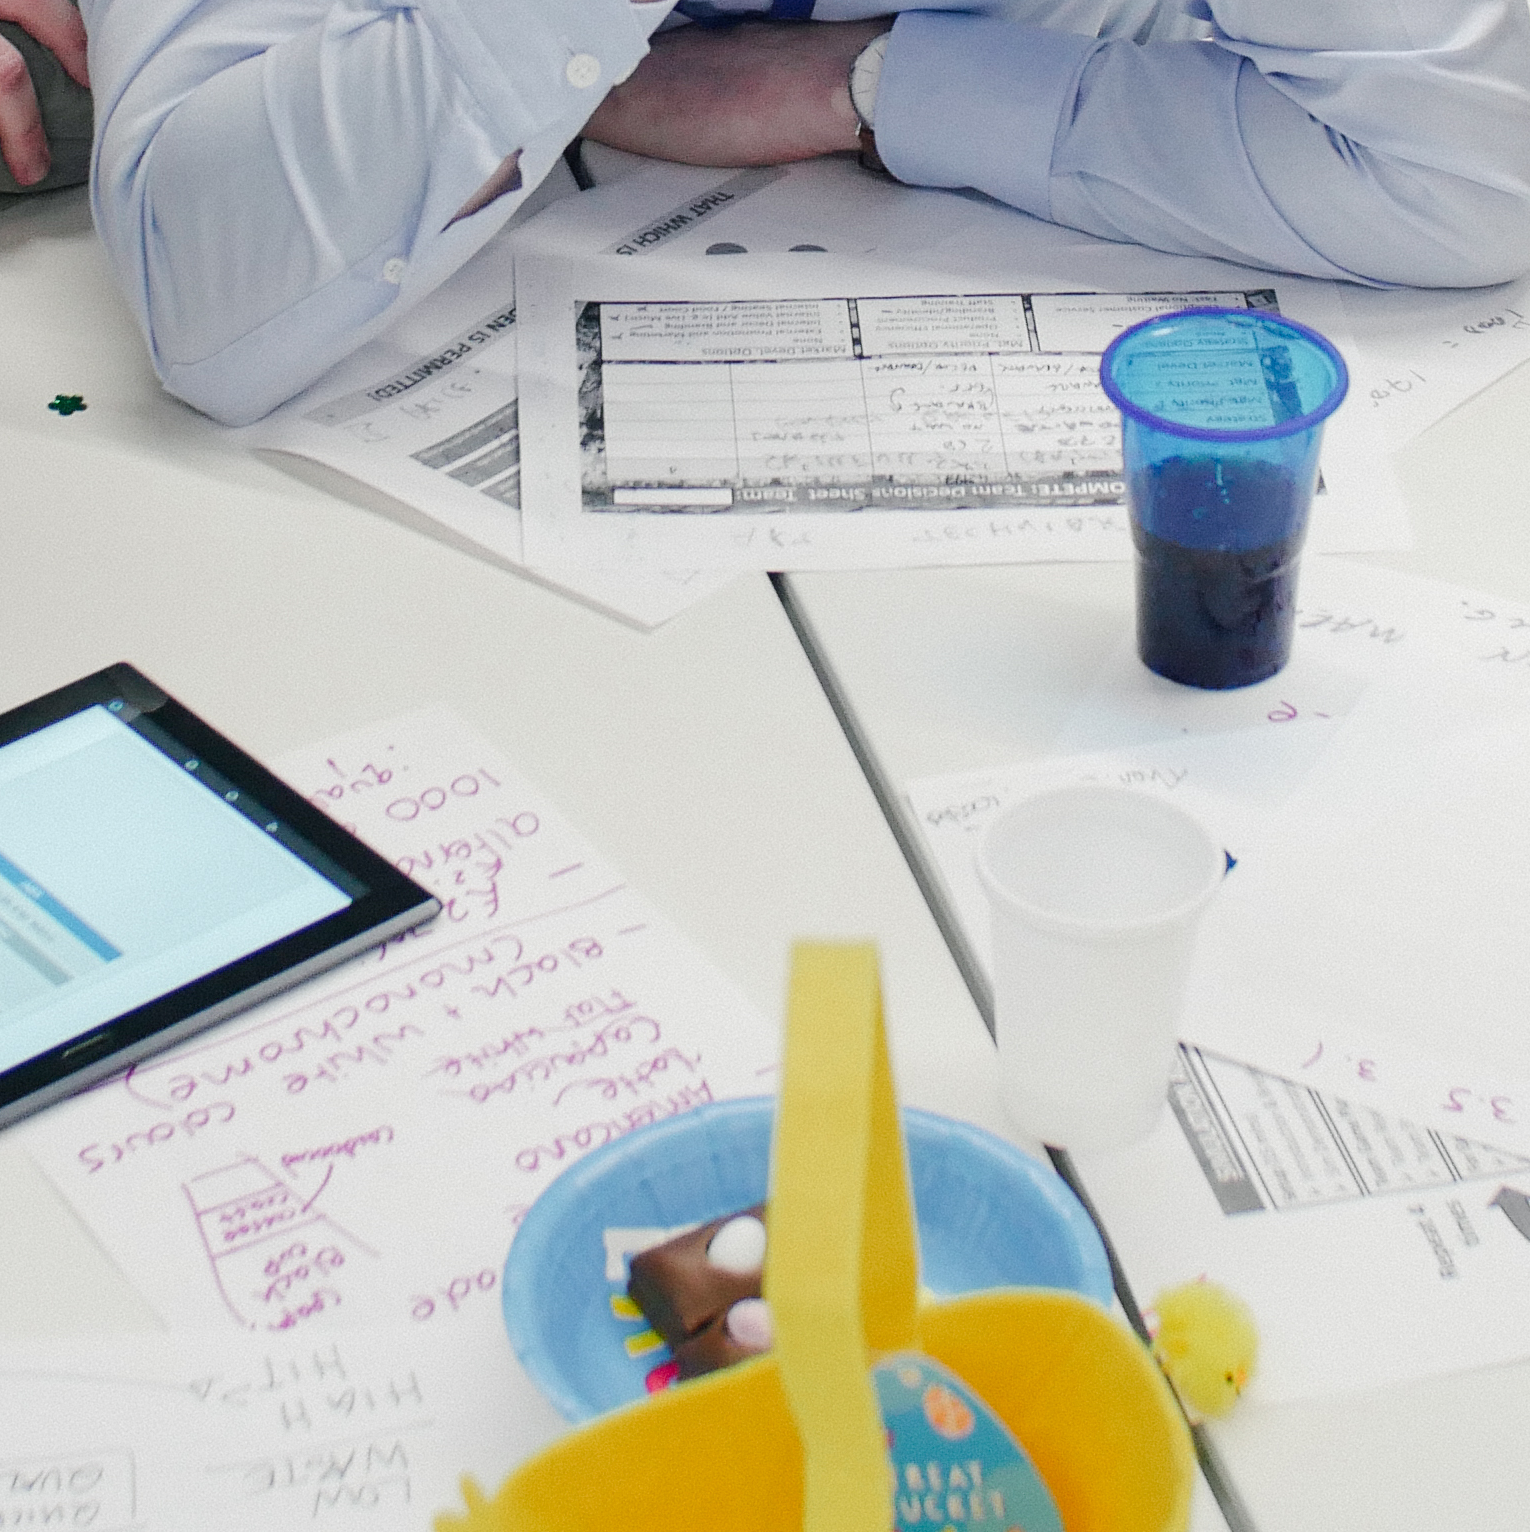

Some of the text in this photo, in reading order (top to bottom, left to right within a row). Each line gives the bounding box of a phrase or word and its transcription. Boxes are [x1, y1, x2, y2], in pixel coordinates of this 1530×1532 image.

[690, 192, 734, 216] THAT
[633, 215, 693, 247] WHICH
[468, 330, 490, 344] IS
[366, 343, 471, 402] PERMITTED!
[808, 488, 866, 501] Sheet
[872, 485, 965, 498] Decisions
[972, 485, 1023, 496] Team
[1032, 481, 1127, 496] OMPETE:
[385, 768, 501, 822] 1000
[894, 1489, 1006, 1524] UCKET
